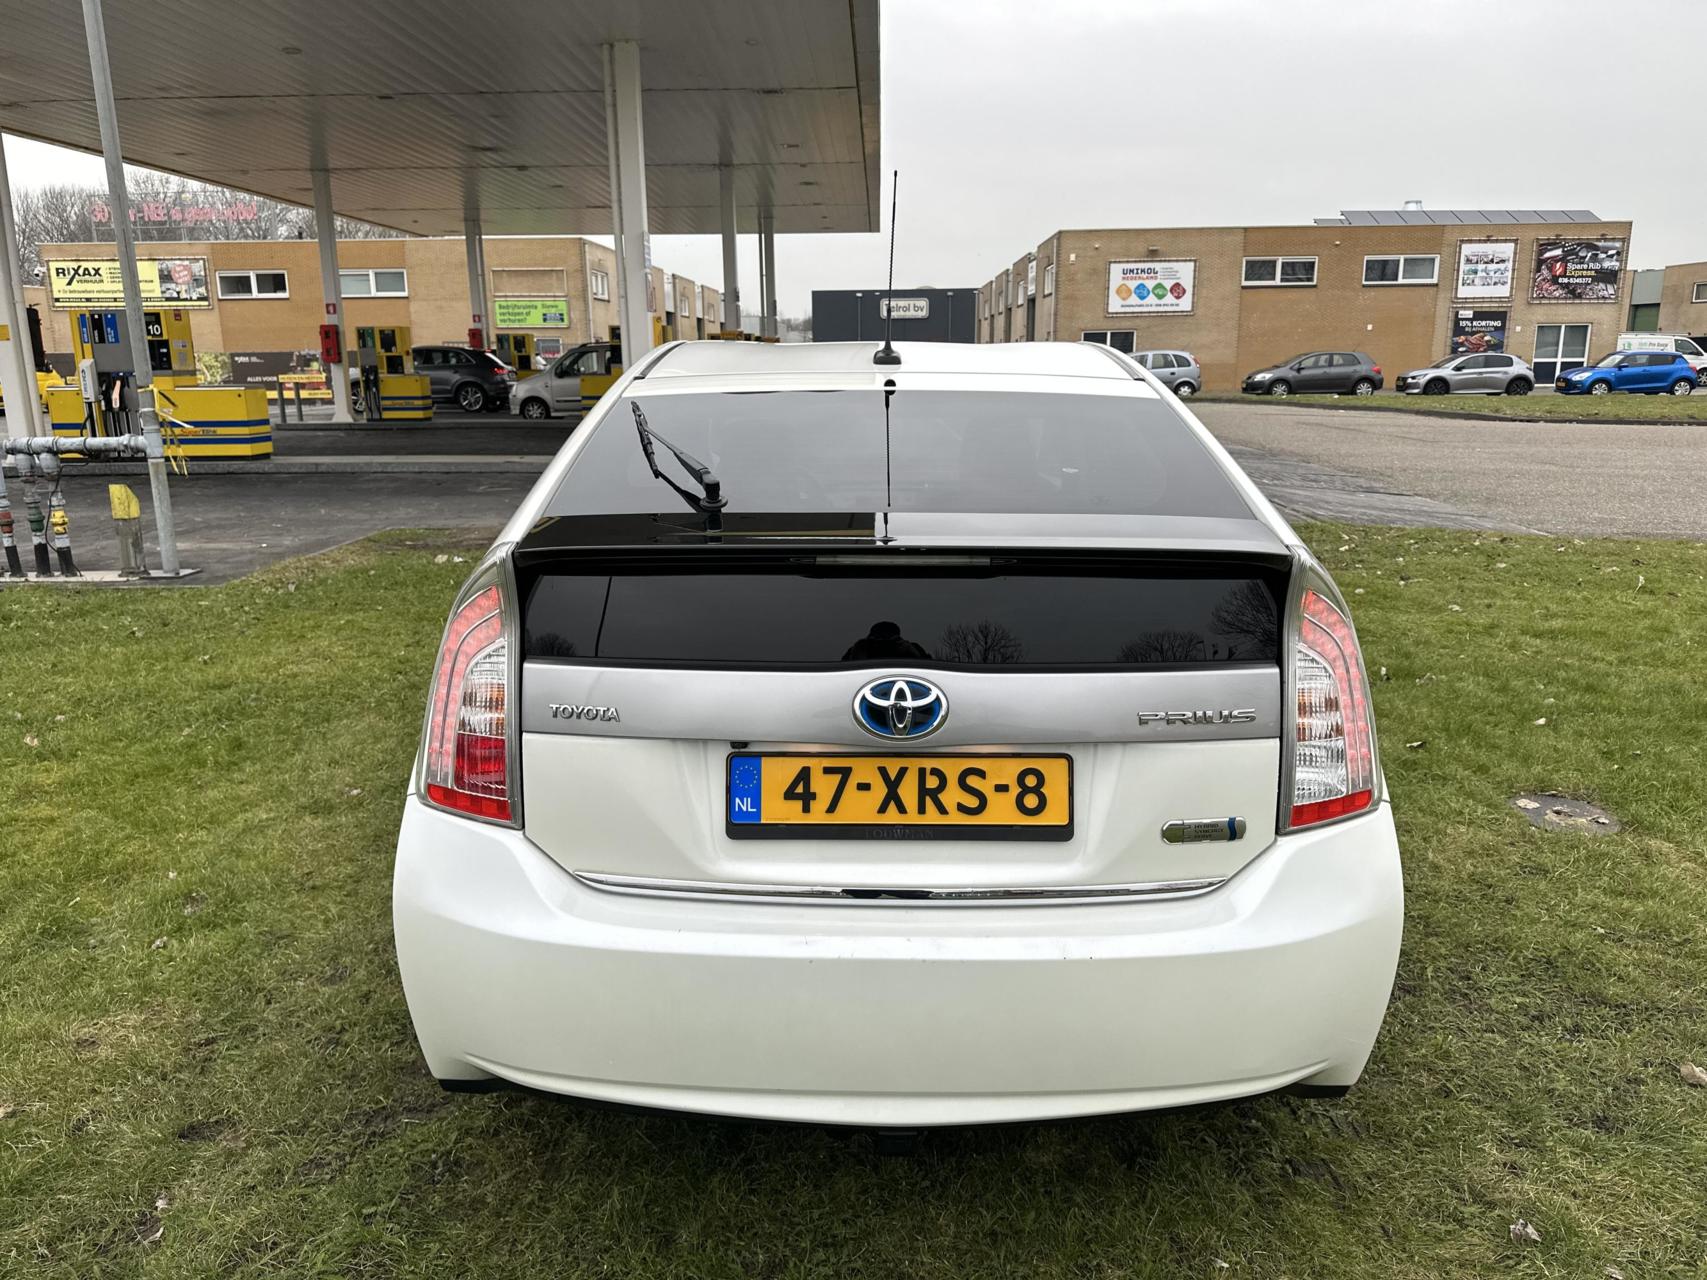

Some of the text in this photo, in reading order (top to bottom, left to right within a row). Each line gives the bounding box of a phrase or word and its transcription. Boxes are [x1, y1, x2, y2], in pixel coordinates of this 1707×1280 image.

[913, 303, 925, 312] bv
[148, 324, 161, 335] 10
[548, 703, 620, 723] TOYOTA
[1137, 708, 1257, 727] PRIUS
[783, 765, 1048, 817] 47-XRS-8
[735, 797, 757, 812] NL
